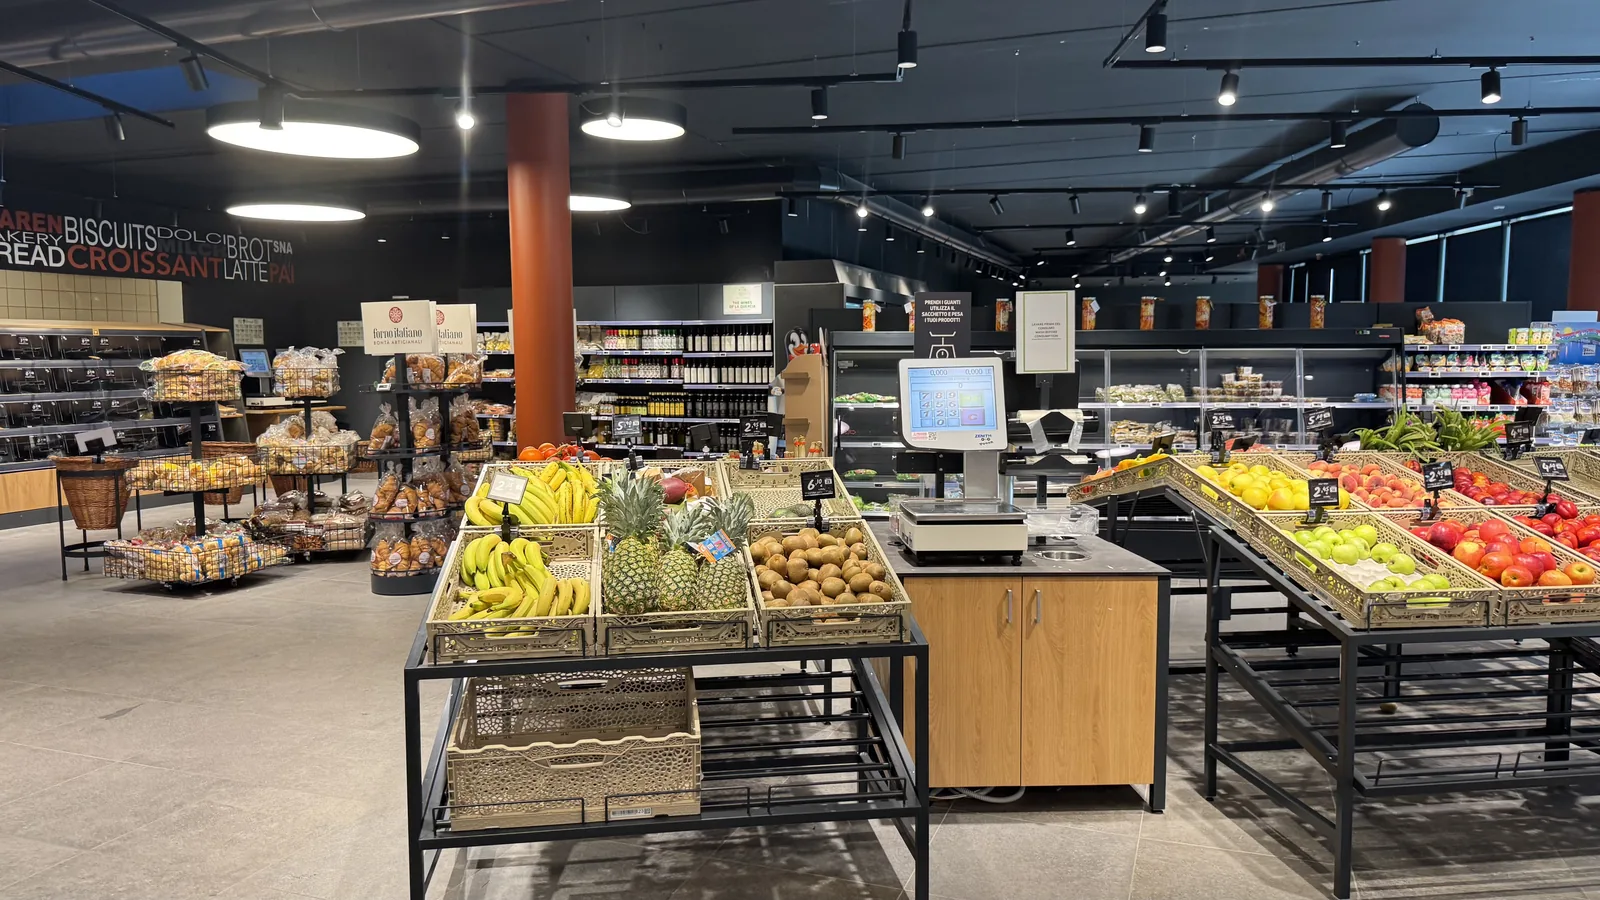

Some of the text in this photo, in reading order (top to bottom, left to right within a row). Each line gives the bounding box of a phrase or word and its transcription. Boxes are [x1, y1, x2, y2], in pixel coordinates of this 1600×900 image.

[64, 215, 158, 251] BISCUITS
[157, 226, 226, 244] DOLCI
[227, 234, 272, 262] BROT
[67, 245, 222, 279] CROISSANT
[223, 258, 269, 282] LATTE
[373, 328, 394, 339] forno
[394, 327, 422, 338] italiano
[438, 329, 463, 339] taliano
[935, 391, 943, 399] 8
